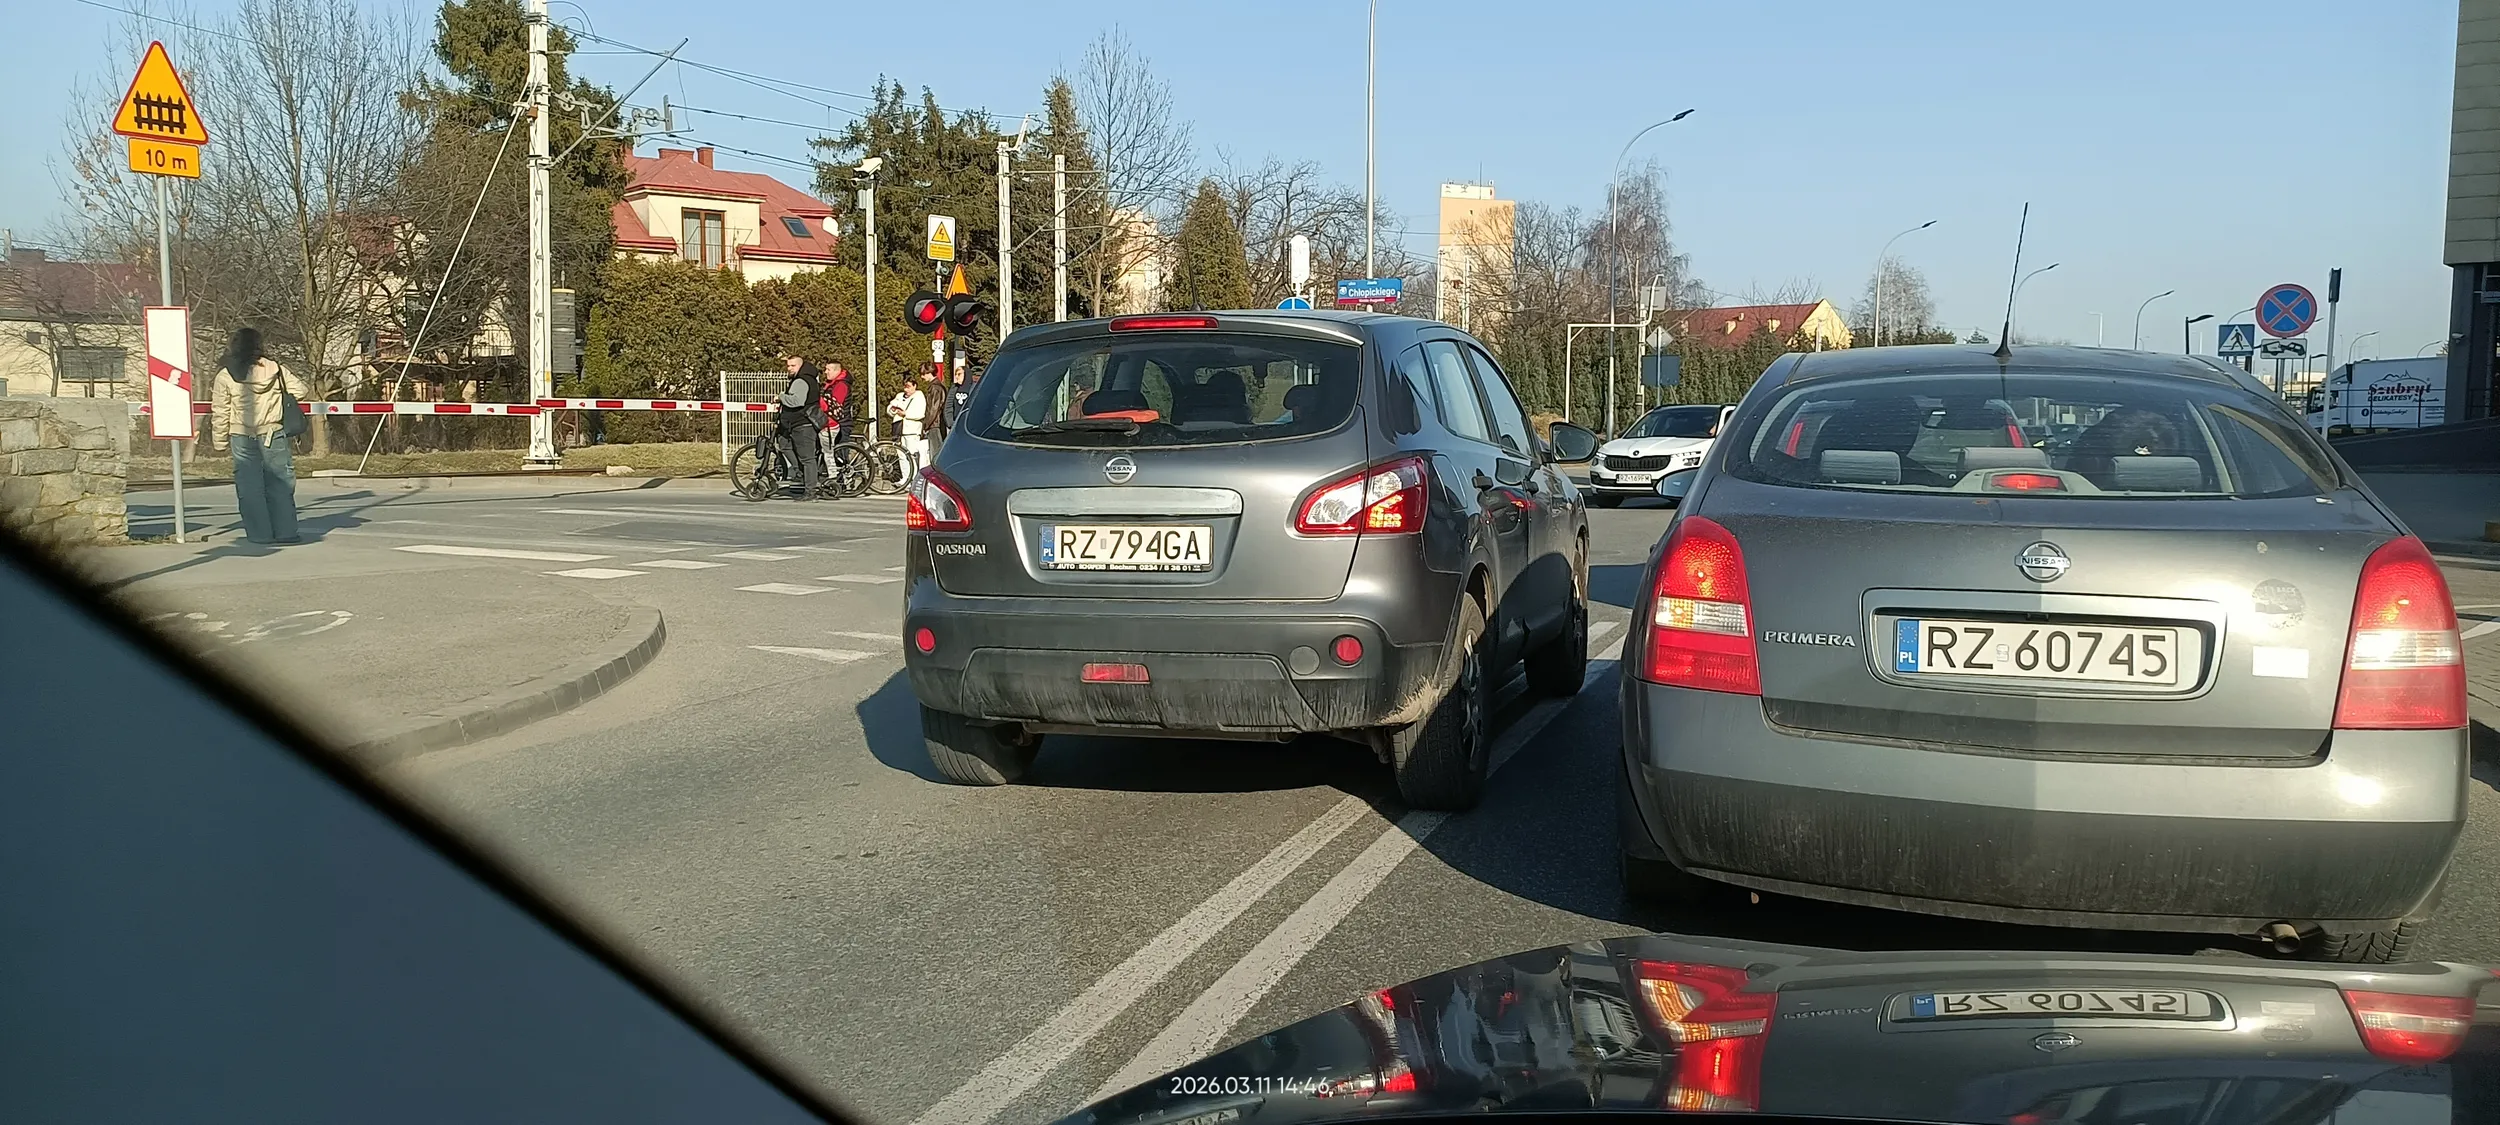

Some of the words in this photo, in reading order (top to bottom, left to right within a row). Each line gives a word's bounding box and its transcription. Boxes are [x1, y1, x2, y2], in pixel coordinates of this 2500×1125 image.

[145, 148, 166, 168] 10
[172, 157, 187, 170] m
[2368, 394, 2413, 402] DELIKATESY
[936, 543, 987, 556] QASHQAI
[1043, 548, 1054, 557] PL
[1060, 529, 1097, 560] RZ
[1109, 530, 1201, 560] 794GA
[1763, 630, 1856, 647] PRIMERA
[1899, 651, 1916, 664] PL
[1926, 625, 1995, 670] RZ
[2014, 629, 2168, 677] 60745
